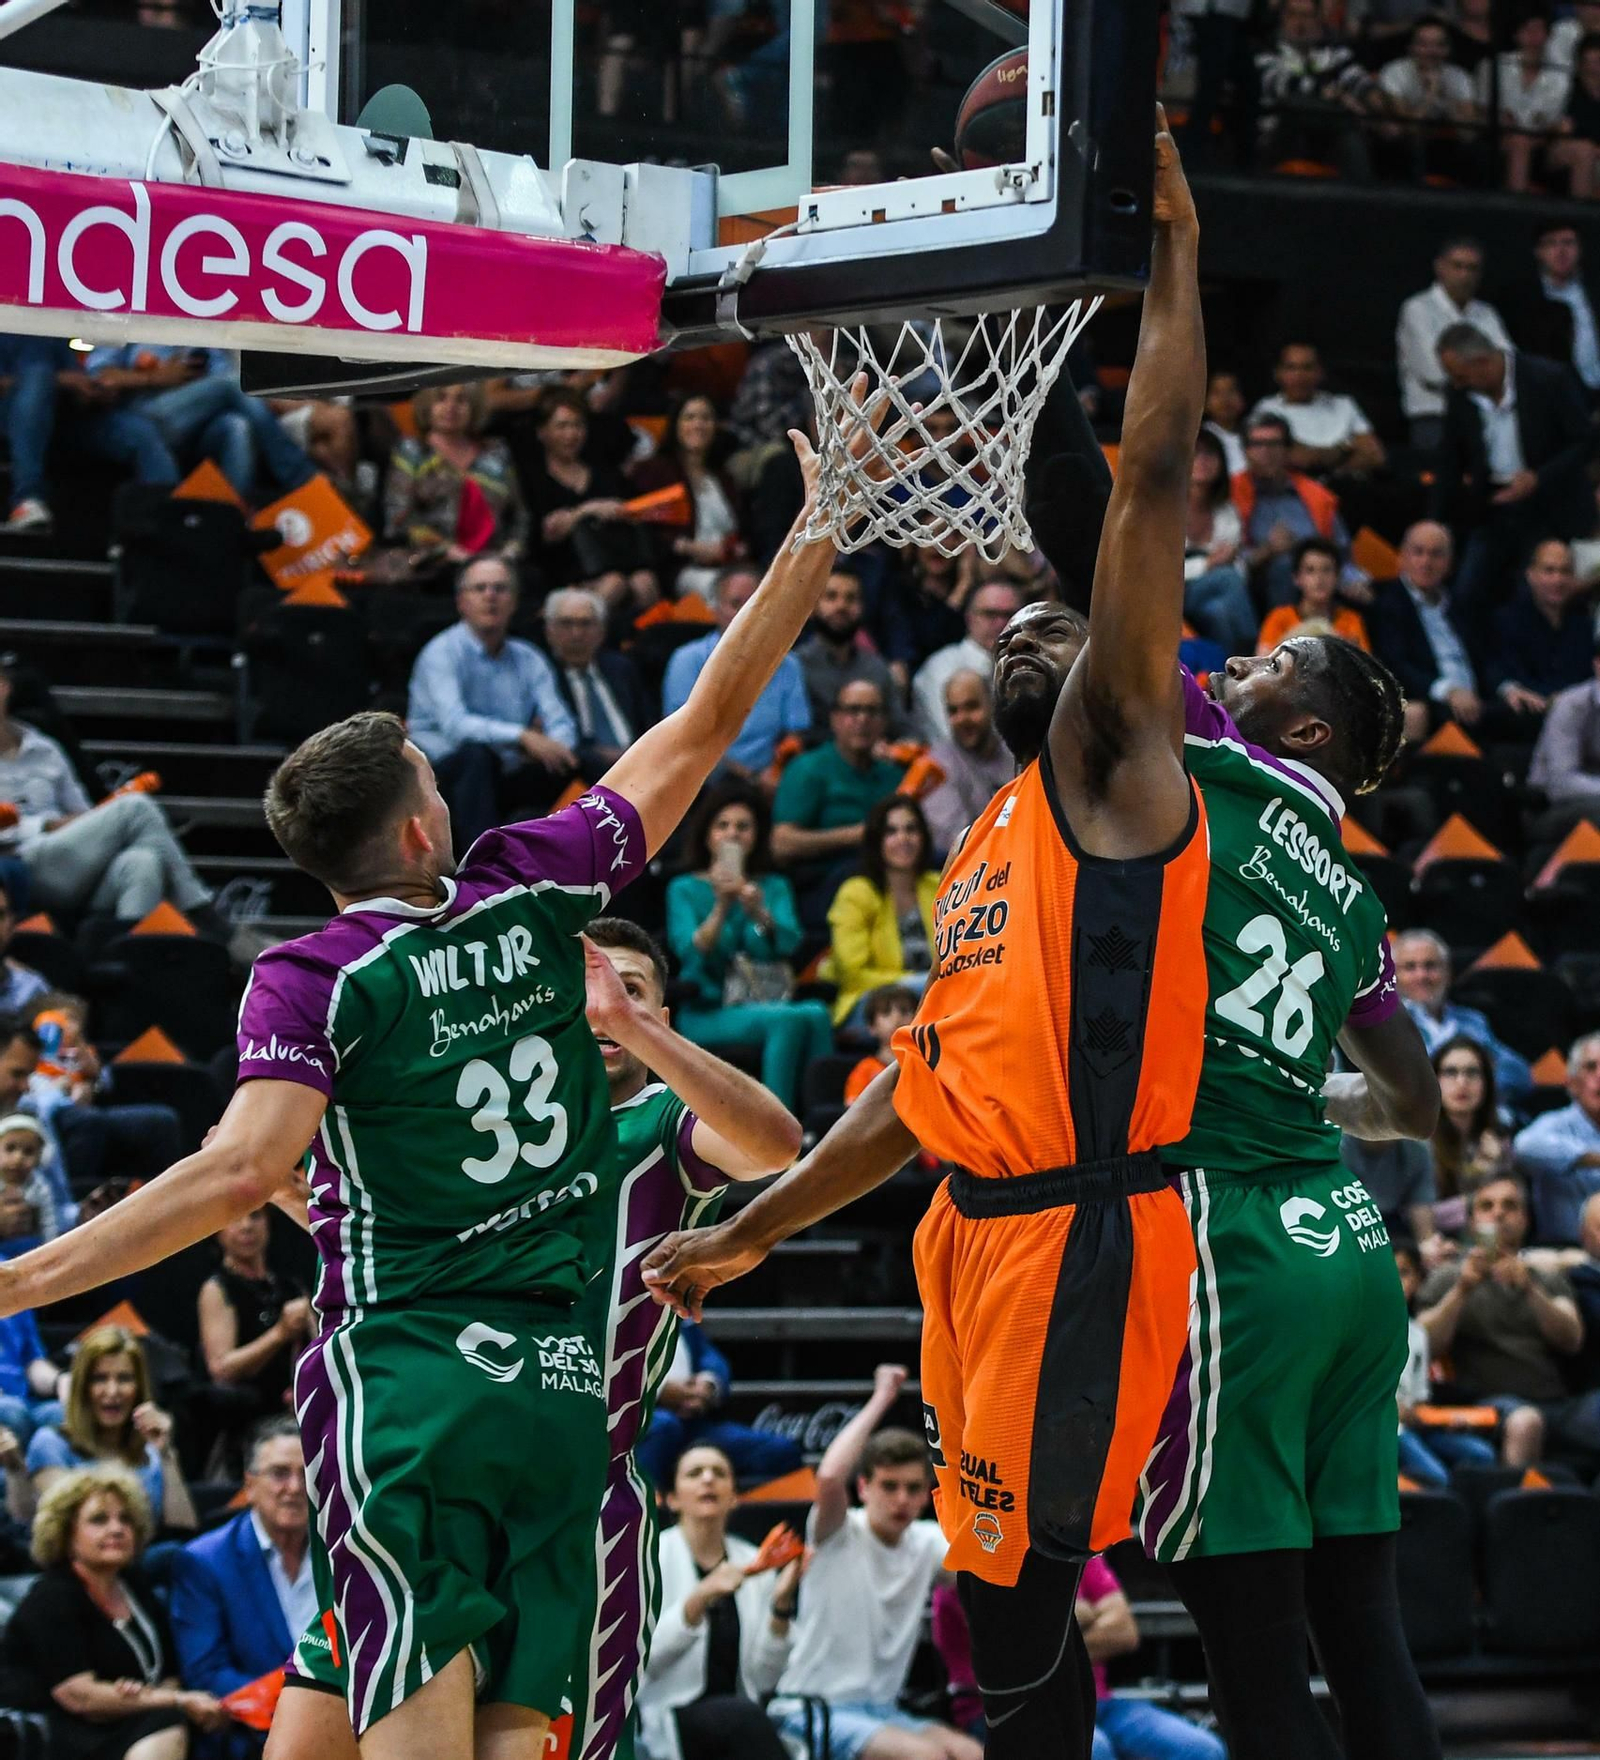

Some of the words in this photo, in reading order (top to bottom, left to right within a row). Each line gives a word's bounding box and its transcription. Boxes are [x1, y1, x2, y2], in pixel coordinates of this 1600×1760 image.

[1258, 797, 1363, 915] LESSORT
[986, 861, 1011, 892] del
[1214, 913, 1325, 1059] 26
[455, 1033, 568, 1184] 33
[1344, 1206, 1378, 1232] DEL
[538, 1349, 579, 1372] DEL
[541, 1371, 605, 1400] MÁLAG
